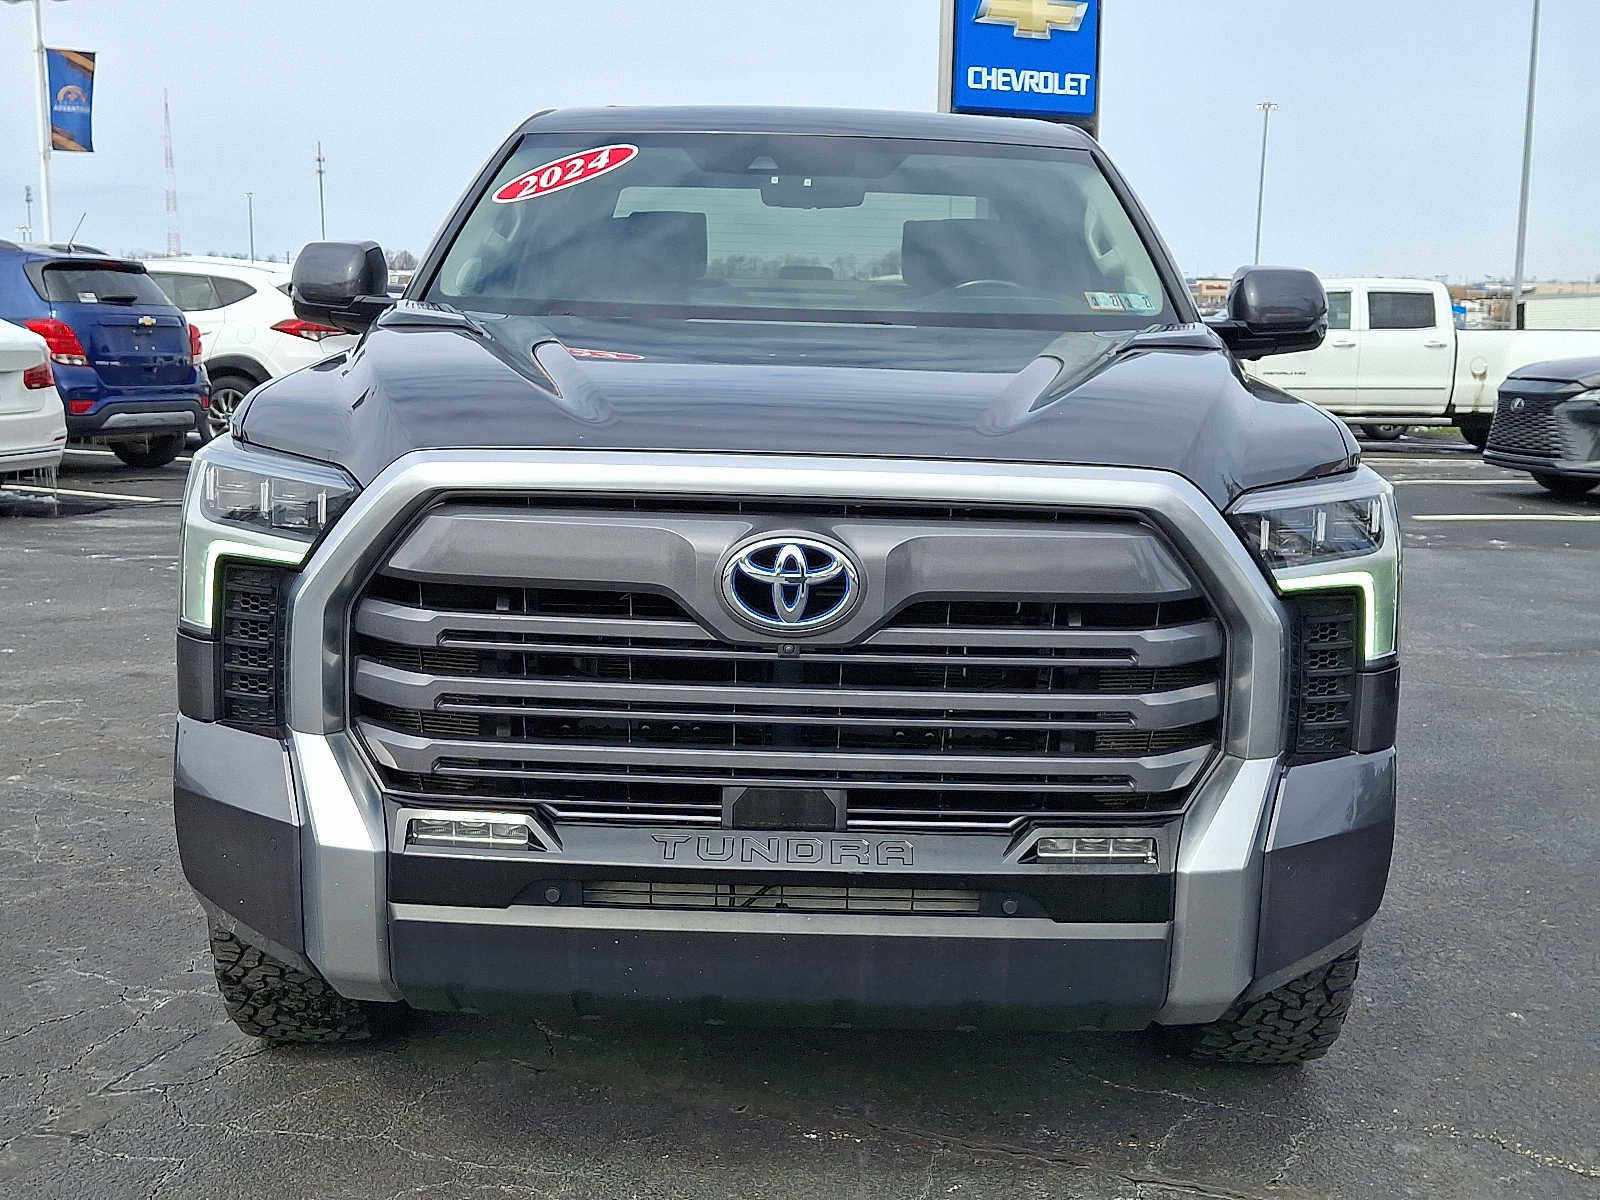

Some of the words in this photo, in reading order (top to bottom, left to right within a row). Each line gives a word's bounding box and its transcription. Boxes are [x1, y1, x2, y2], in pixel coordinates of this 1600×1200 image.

[967, 66, 1090, 96] CHEVROLET
[516, 148, 611, 198] 2024
[651, 833, 914, 866] TUNDRA
